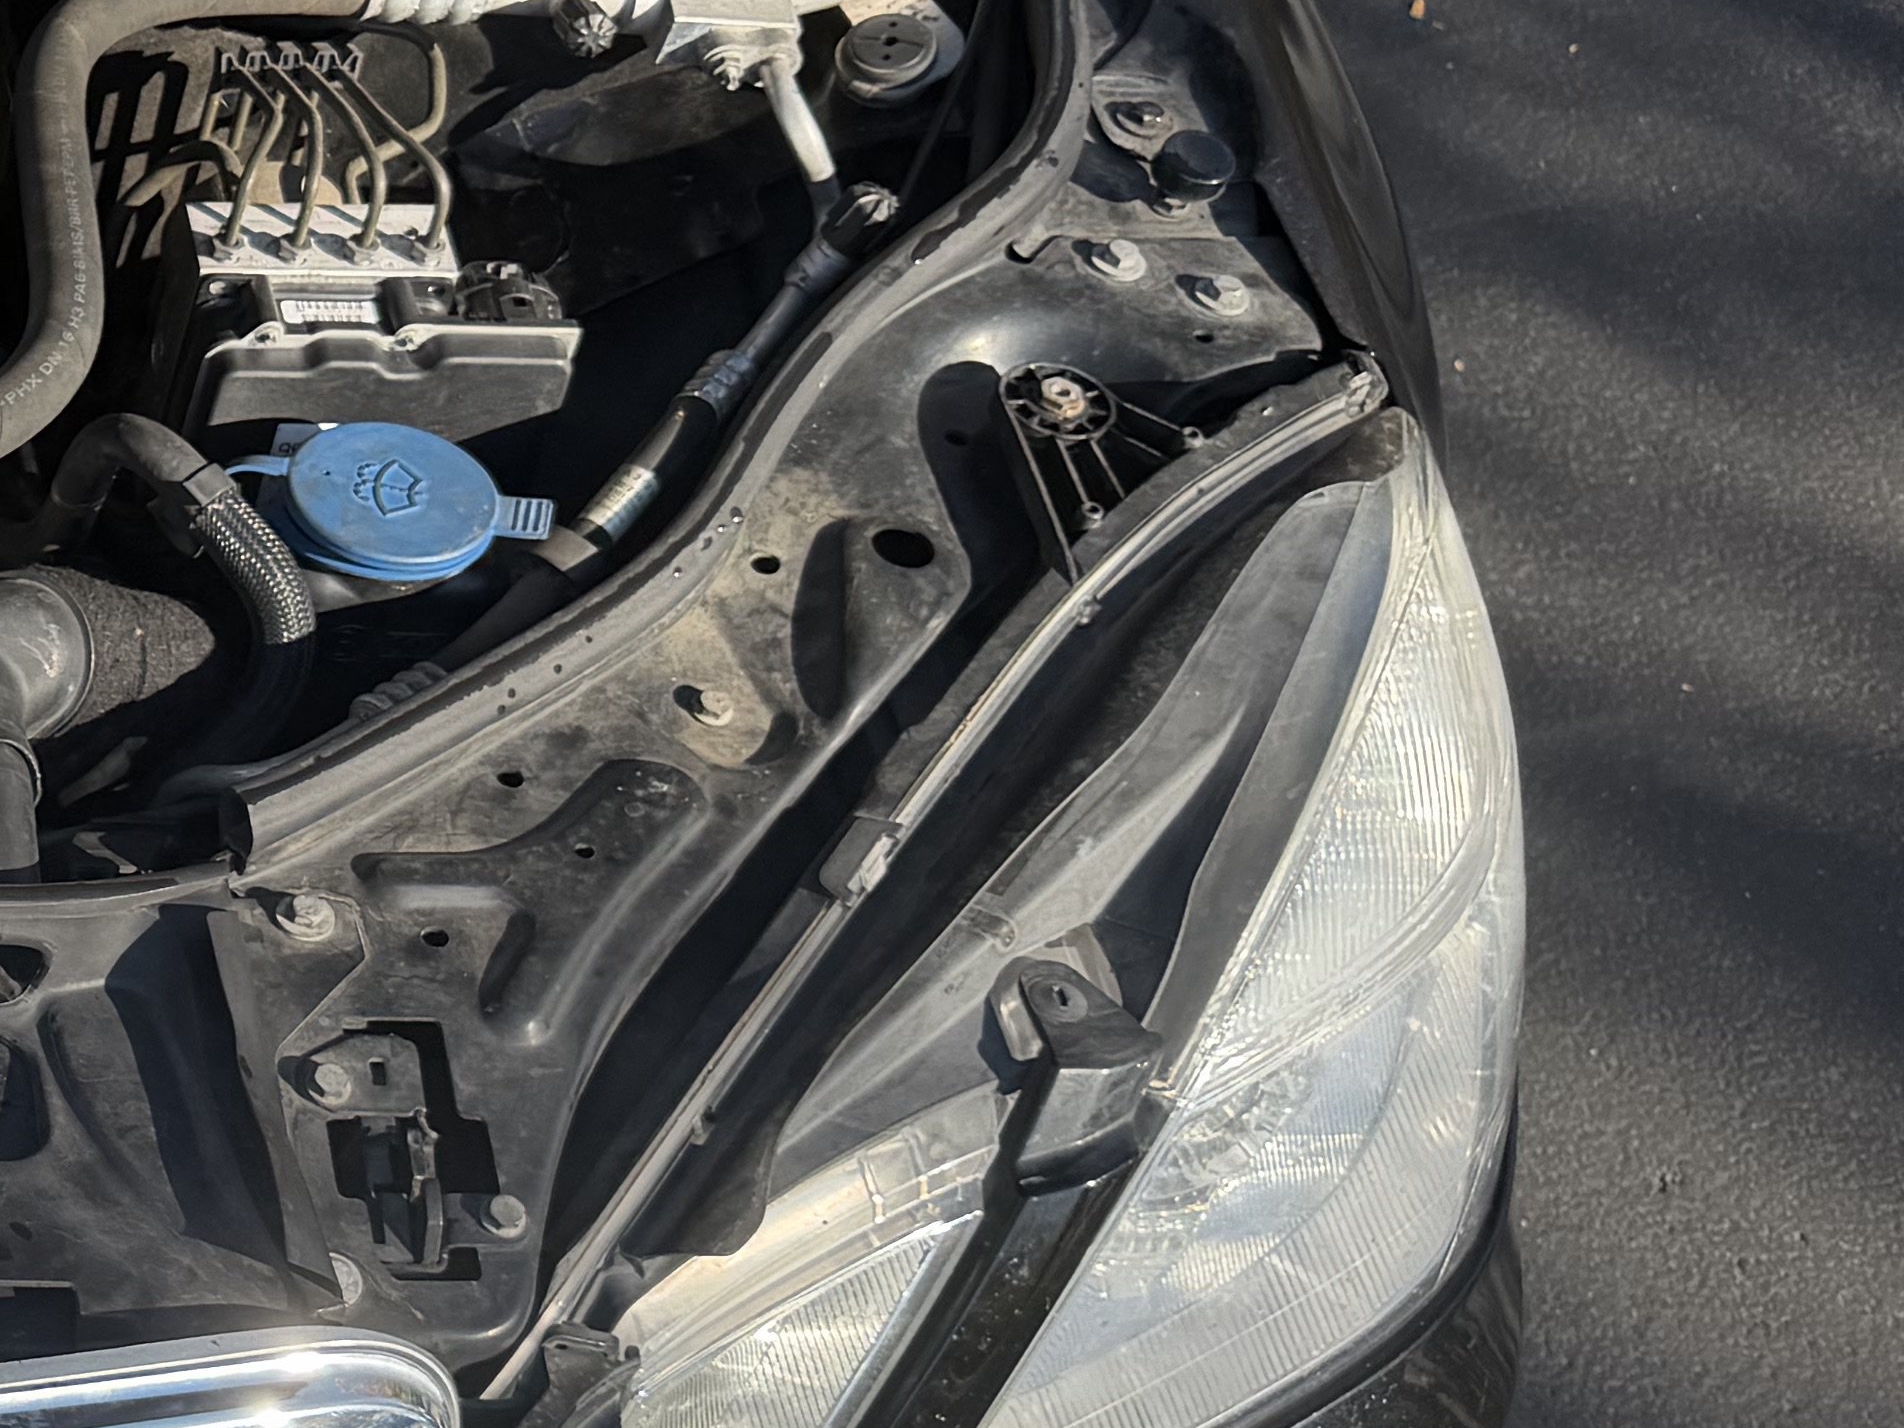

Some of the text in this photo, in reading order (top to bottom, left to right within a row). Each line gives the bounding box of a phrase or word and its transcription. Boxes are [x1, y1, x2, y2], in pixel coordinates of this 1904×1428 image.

[4, 373, 43, 405] PHX
[39, 351, 63, 376] DN
[67, 306, 86, 330] H3
